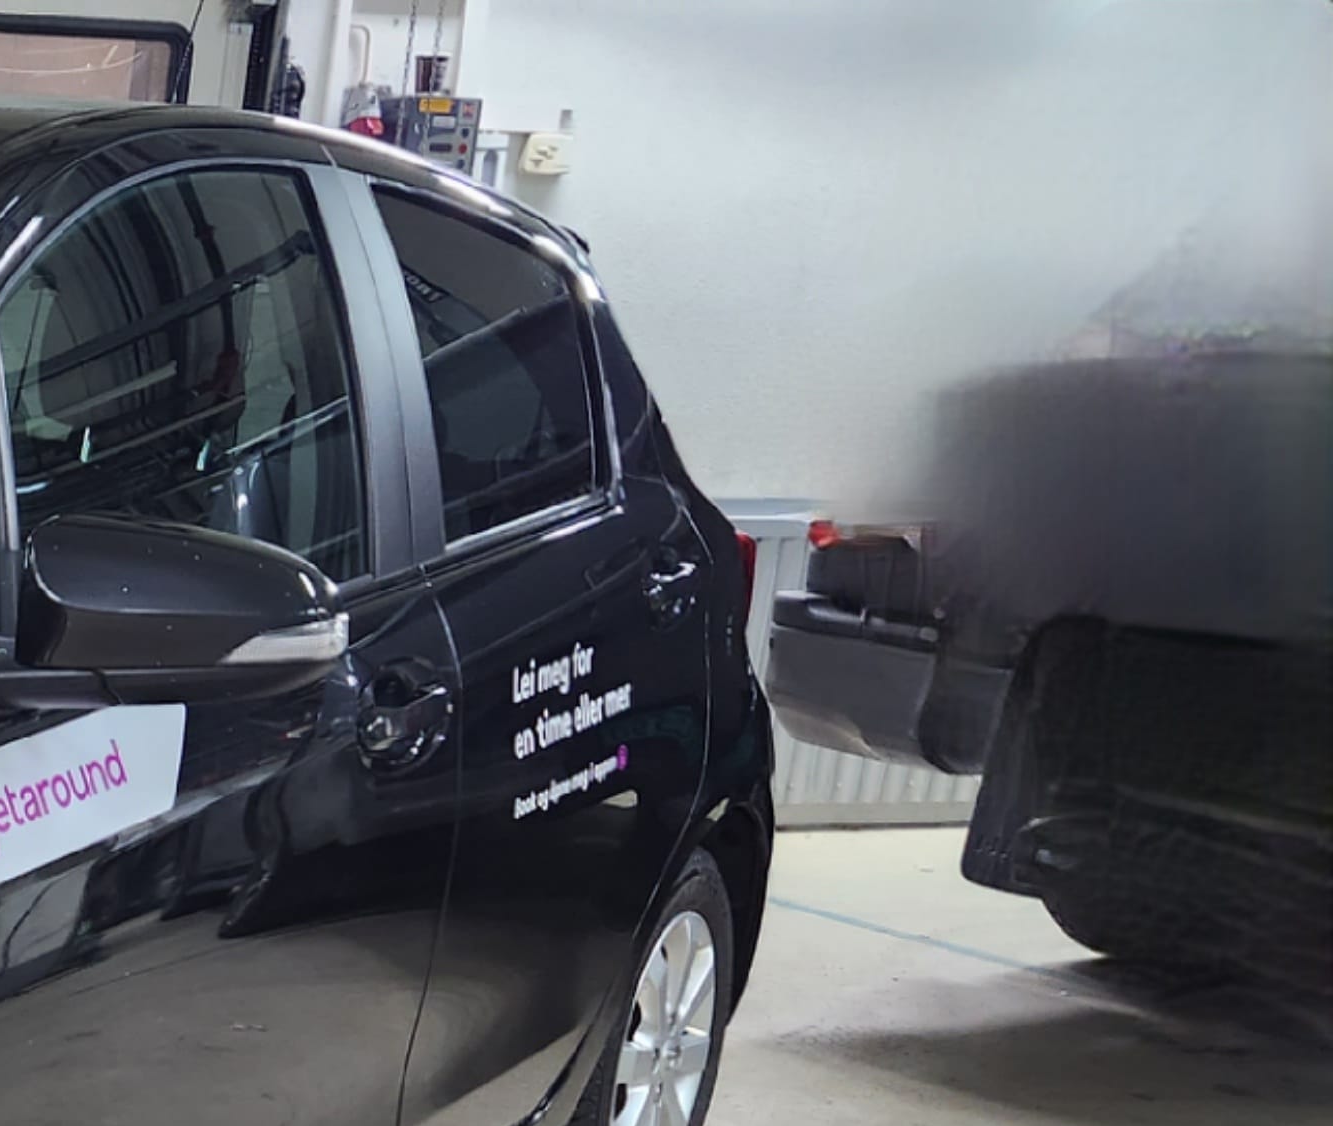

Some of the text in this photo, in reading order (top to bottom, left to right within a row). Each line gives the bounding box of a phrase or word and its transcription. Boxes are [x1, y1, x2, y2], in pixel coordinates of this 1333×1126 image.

[512, 642, 594, 703] Lei meg for
[514, 683, 632, 759] en time eller mer
